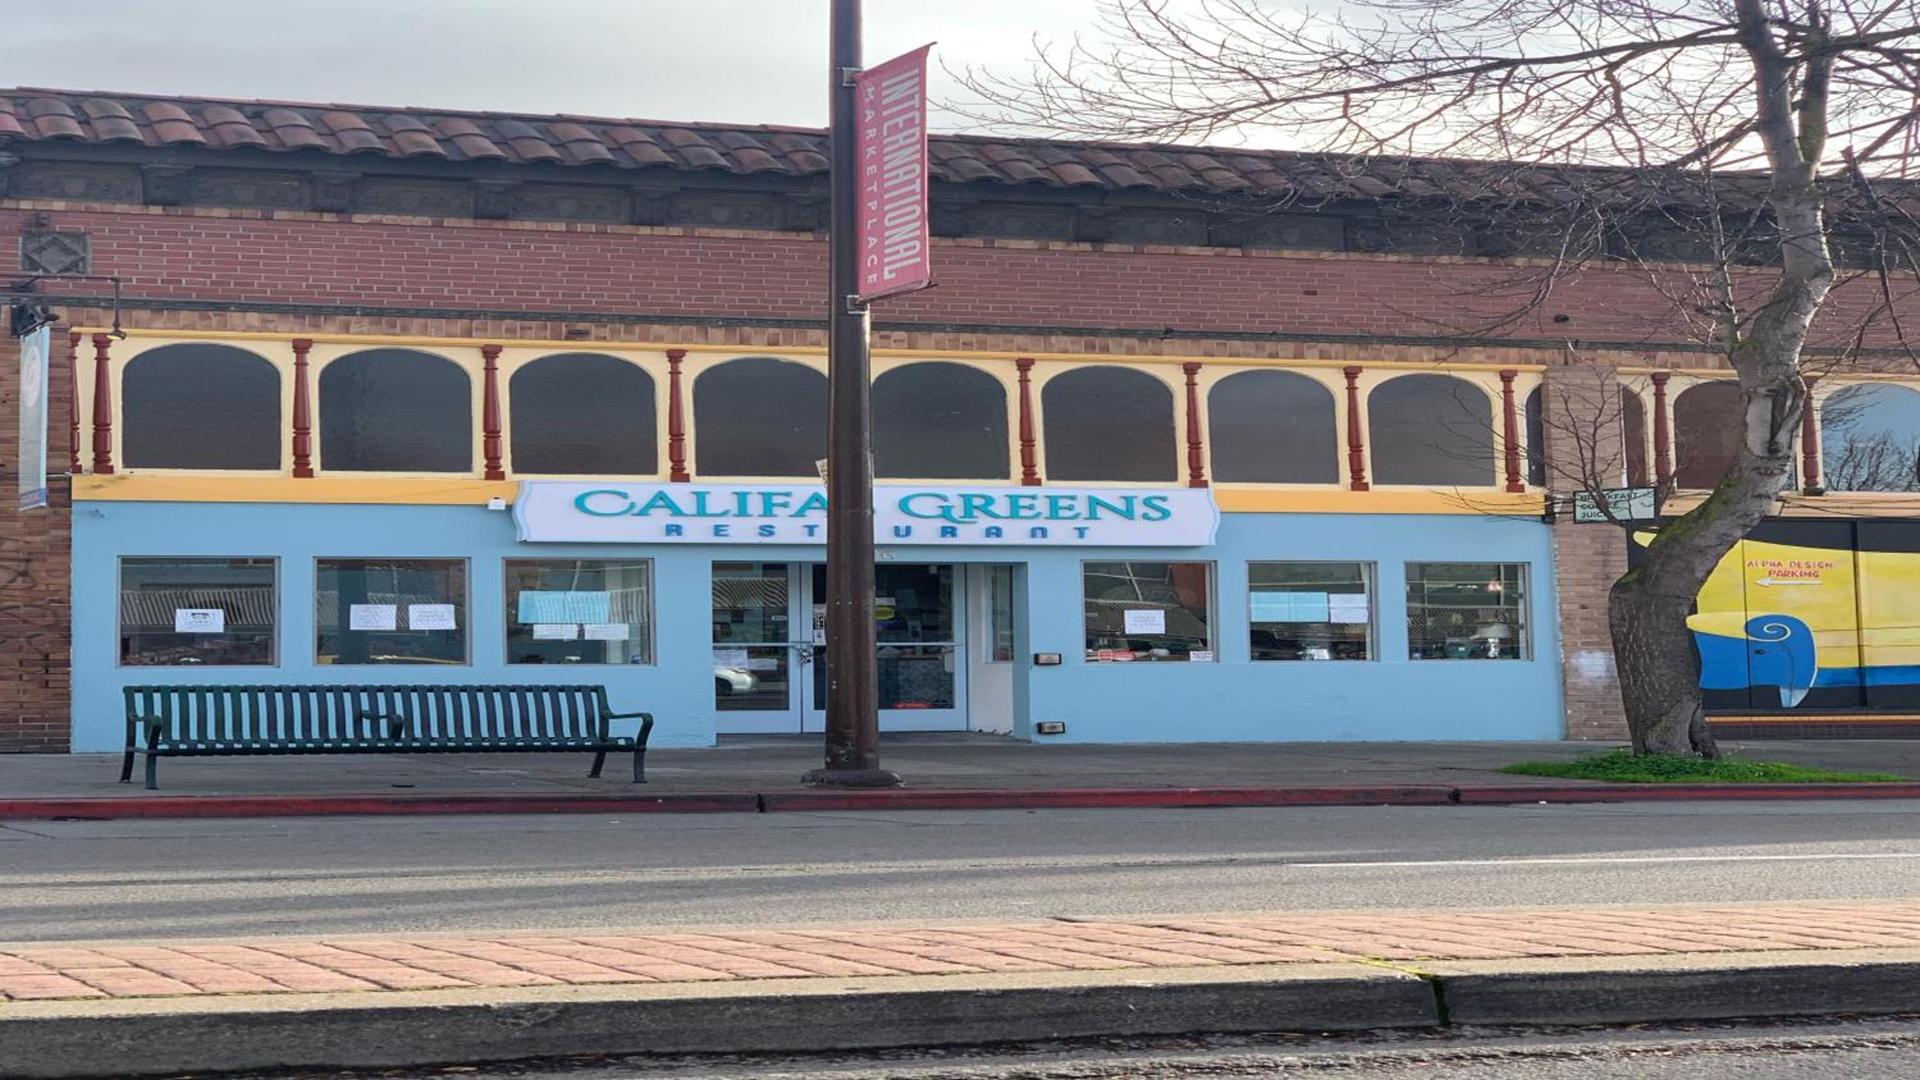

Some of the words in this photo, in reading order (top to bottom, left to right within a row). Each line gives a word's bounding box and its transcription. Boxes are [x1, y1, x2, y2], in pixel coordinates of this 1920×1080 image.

[881, 68, 921, 281] INTERNATIONAL
[863, 86, 878, 285] MARKETPLACE
[1580, 491, 1638, 501] BRKFAST
[899, 492, 1172, 524] GREENS
[664, 524, 1091, 539] RESTURANT
[1747, 560, 1783, 568] ALPHA
[1789, 561, 1833, 569] DESIGN
[1768, 570, 1820, 579] PARKING
